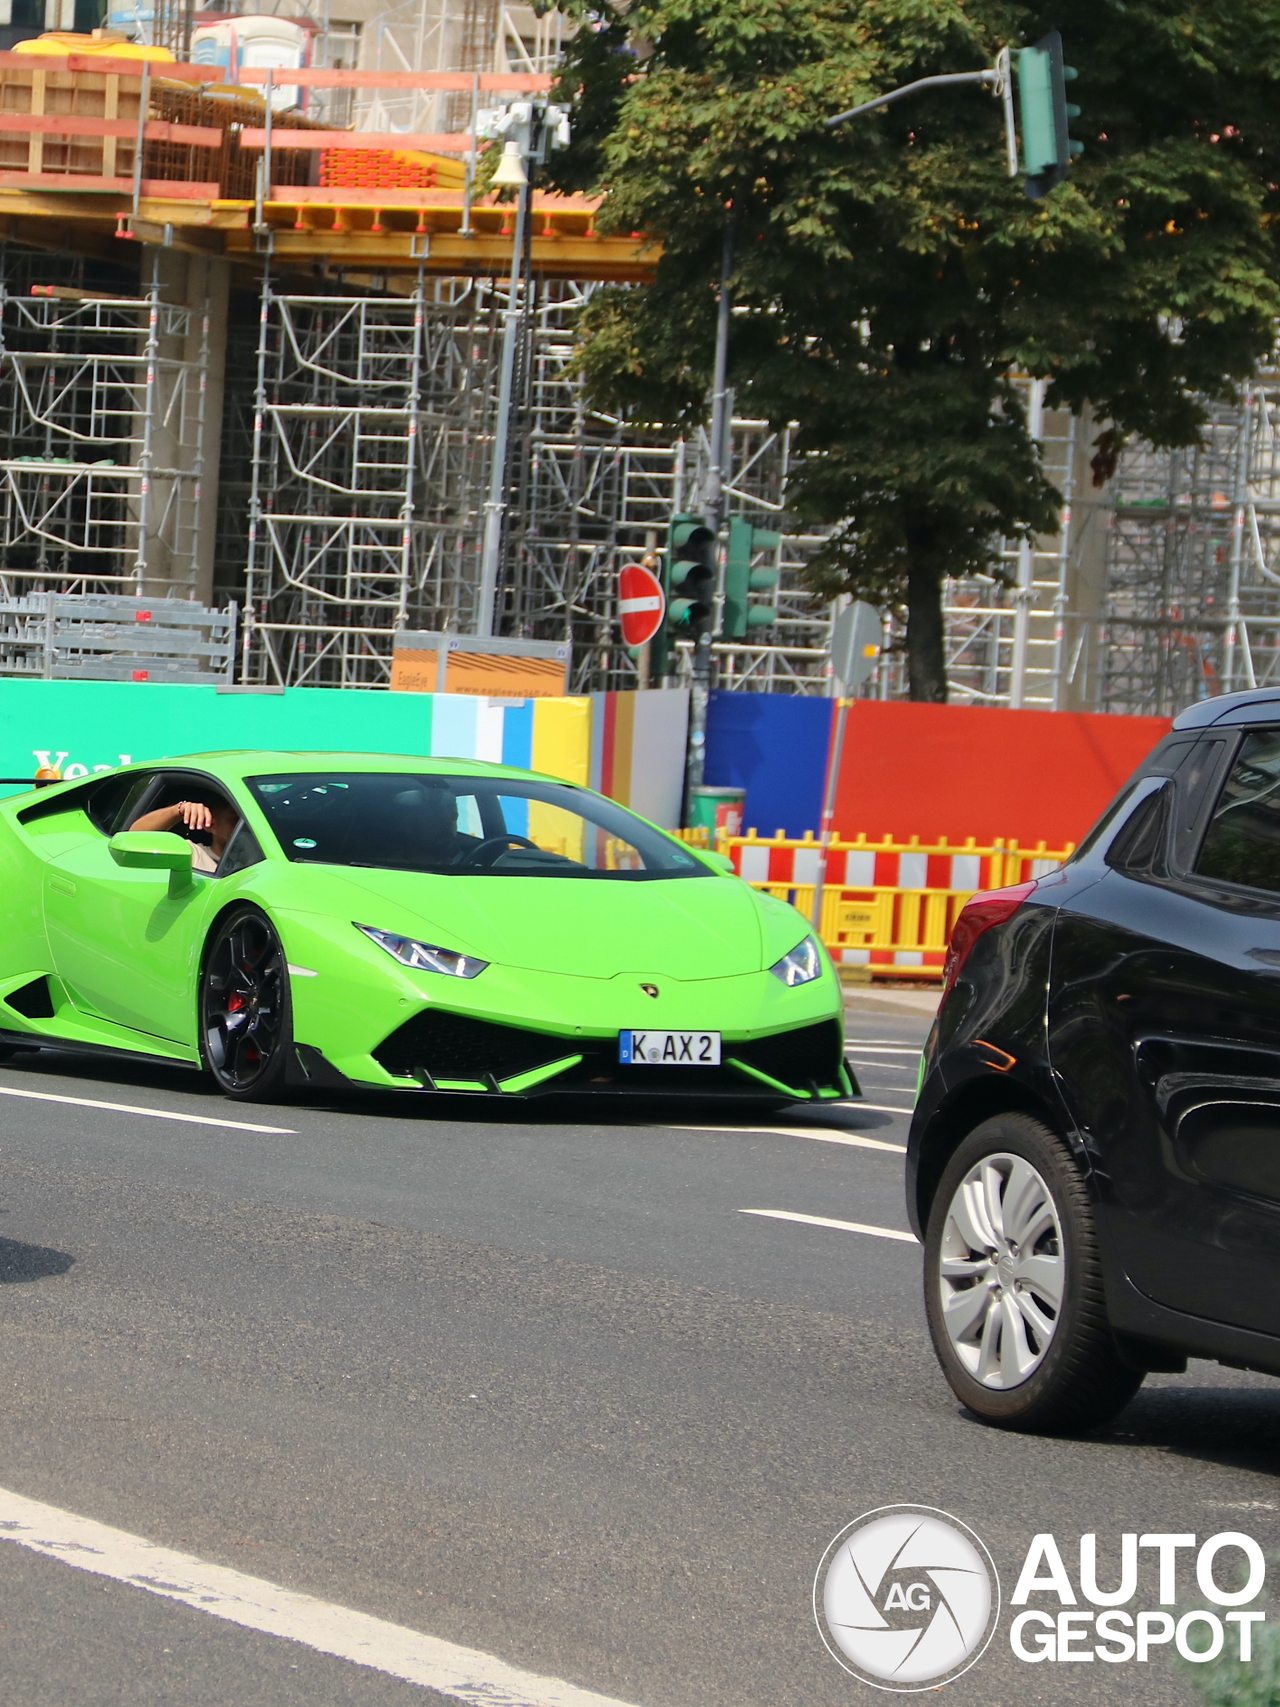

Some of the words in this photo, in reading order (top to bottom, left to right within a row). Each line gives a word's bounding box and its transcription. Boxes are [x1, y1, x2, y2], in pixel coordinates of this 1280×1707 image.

[622, 1050, 629, 1058] D
[632, 1034, 646, 1060] K
[662, 1035, 693, 1061] AX
[699, 1035, 712, 1061] 2
